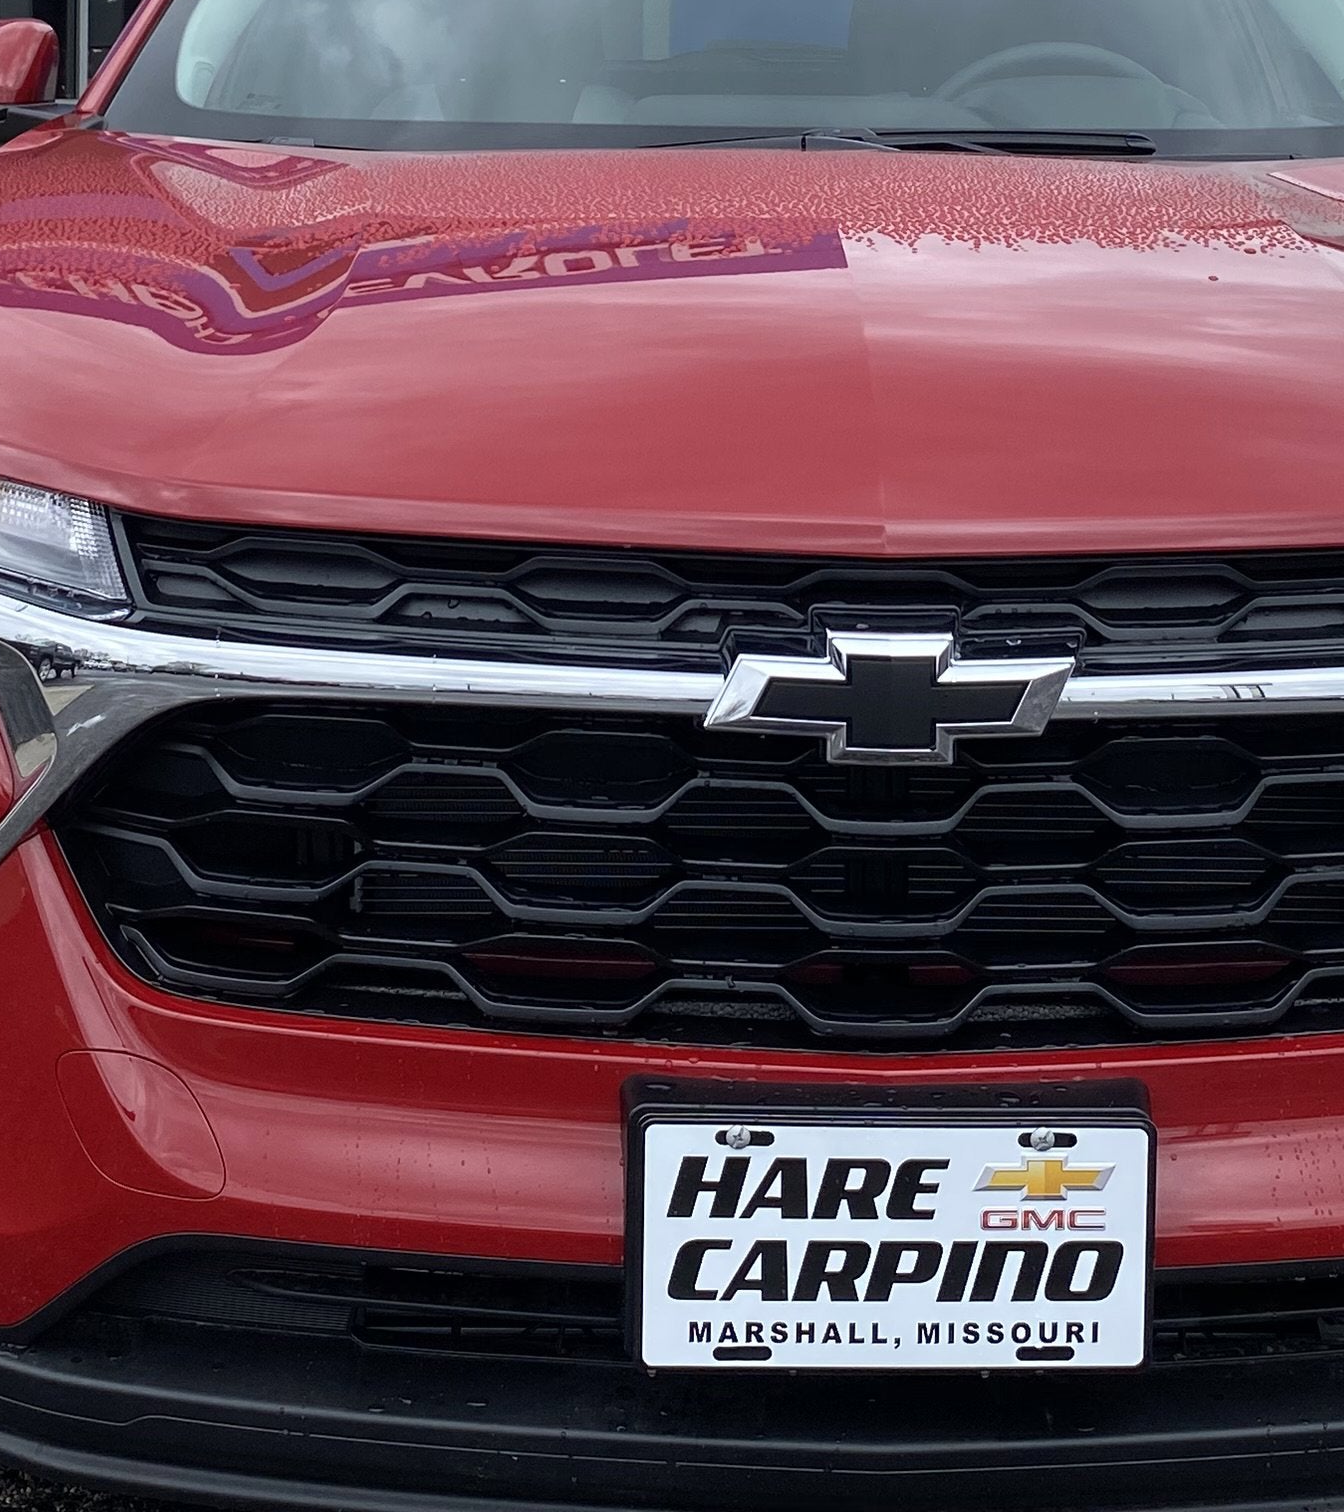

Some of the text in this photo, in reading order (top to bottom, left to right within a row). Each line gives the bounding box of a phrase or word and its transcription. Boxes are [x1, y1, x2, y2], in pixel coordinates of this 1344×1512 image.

[666, 1156, 951, 1220] HARE
[979, 1207, 1107, 1232] GMC
[667, 1239, 1124, 1302] CARPINO
[688, 1321, 1100, 1349] MARSHALL, MISSOURI
